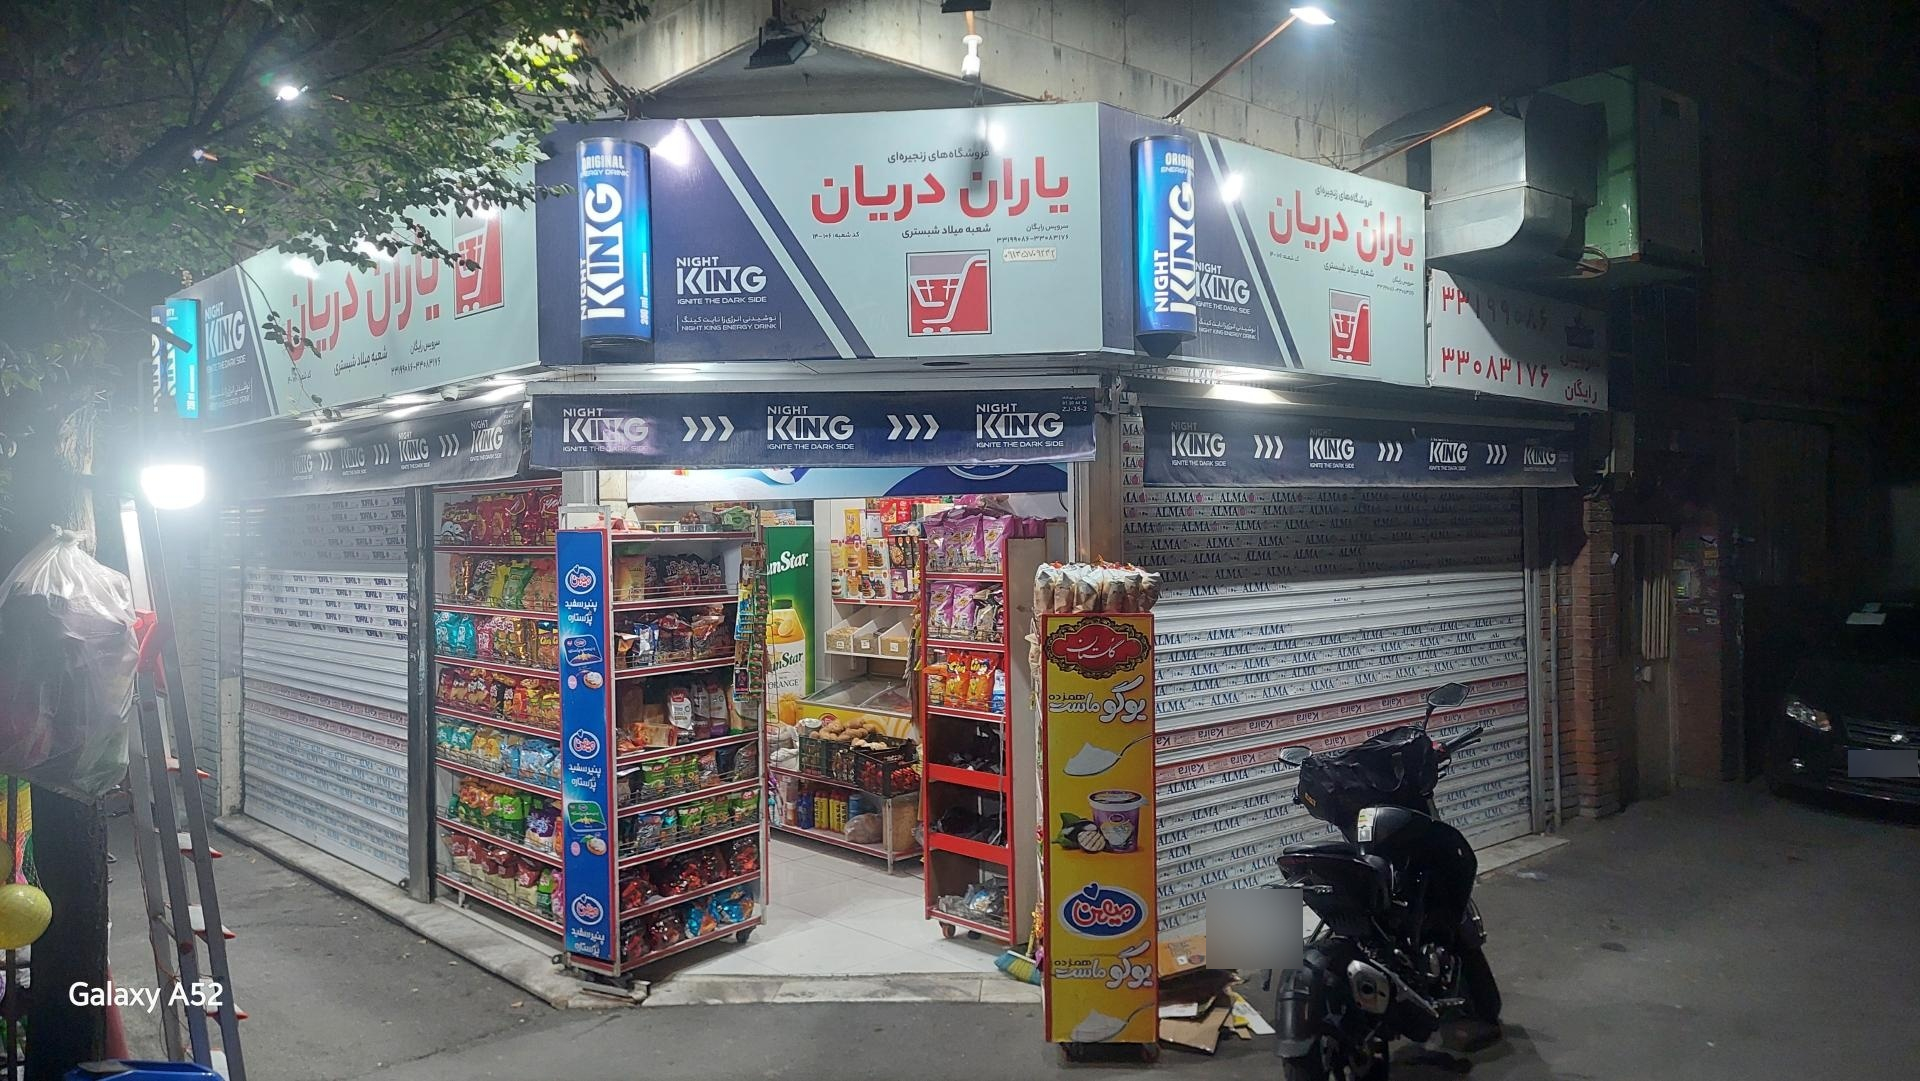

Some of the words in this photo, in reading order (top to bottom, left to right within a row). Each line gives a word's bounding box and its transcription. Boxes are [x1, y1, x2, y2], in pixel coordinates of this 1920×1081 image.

[811, 164, 946, 224] دریان
[959, 156, 1069, 218] یاران
[965, 224, 992, 236] شعبه
[1268, 190, 1349, 253] دریان
[901, 227, 940, 239] شبستری
[942, 225, 964, 237] میلاد
[1356, 211, 1415, 272] یاران
[585, 183, 625, 318] KING
[676, 256, 719, 267] NIGHT
[1195, 262, 1222, 275] NIGHT
[367, 224, 440, 338] یاران
[676, 265, 767, 295] KING
[1154, 250, 1169, 313] NIGHT
[1196, 271, 1250, 304] KING
[677, 297, 703, 305] IGNITE
[722, 296, 746, 304] DARK
[747, 295, 767, 303] SIDE
[205, 301, 224, 320] NIGHT
[287, 271, 359, 361] دریان
[205, 310, 245, 360] KING
[723, 323, 753, 331] ENERGY
[1442, 347, 1549, 388] ۳۳۰۸۳۱۷۶
[1564, 379, 1598, 404] رایگان
[563, 407, 603, 417] NIGHT
[767, 405, 808, 415] NIGHT
[976, 403, 1017, 413] NIGHT
[470, 420, 488, 430] NIGHT
[563, 416, 649, 443] KING
[767, 415, 854, 441] KING
[976, 412, 1064, 439] KING
[471, 426, 503, 454] KING
[1020, 440, 1043, 448] DARK
[1171, 431, 1226, 457] KING
[399, 438, 429, 462] KING
[1309, 437, 1355, 461] KING
[1429, 442, 1468, 463] KING
[1165, 492, 1195, 503] ALMA
[1155, 506, 1185, 518] ALMA
[1181, 521, 1211, 532] ALMA
[1150, 539, 1181, 550] ALMA
[767, 551, 808, 575] unStar
[1192, 553, 1221, 564] ALMA
[1189, 585, 1219, 597] ALMA
[1168, 650, 1198, 663] ALMA
[1438, 621, 1458, 631] ALMA
[1206, 628, 1236, 641] ALMA
[1190, 663, 1219, 676] ALMA
[1243, 672, 1270, 684] ALMA
[768, 679, 798, 690] ORANGE
[1211, 692, 1239, 705] ALMA
[1354, 673, 1377, 685] ALMA
[1167, 780, 1197, 795] ALMA
[1190, 807, 1220, 822] ALMA
[1212, 818, 1241, 833] ALMA
[1229, 846, 1257, 861] ALMA
[1072, 898, 1136, 927] میهن
